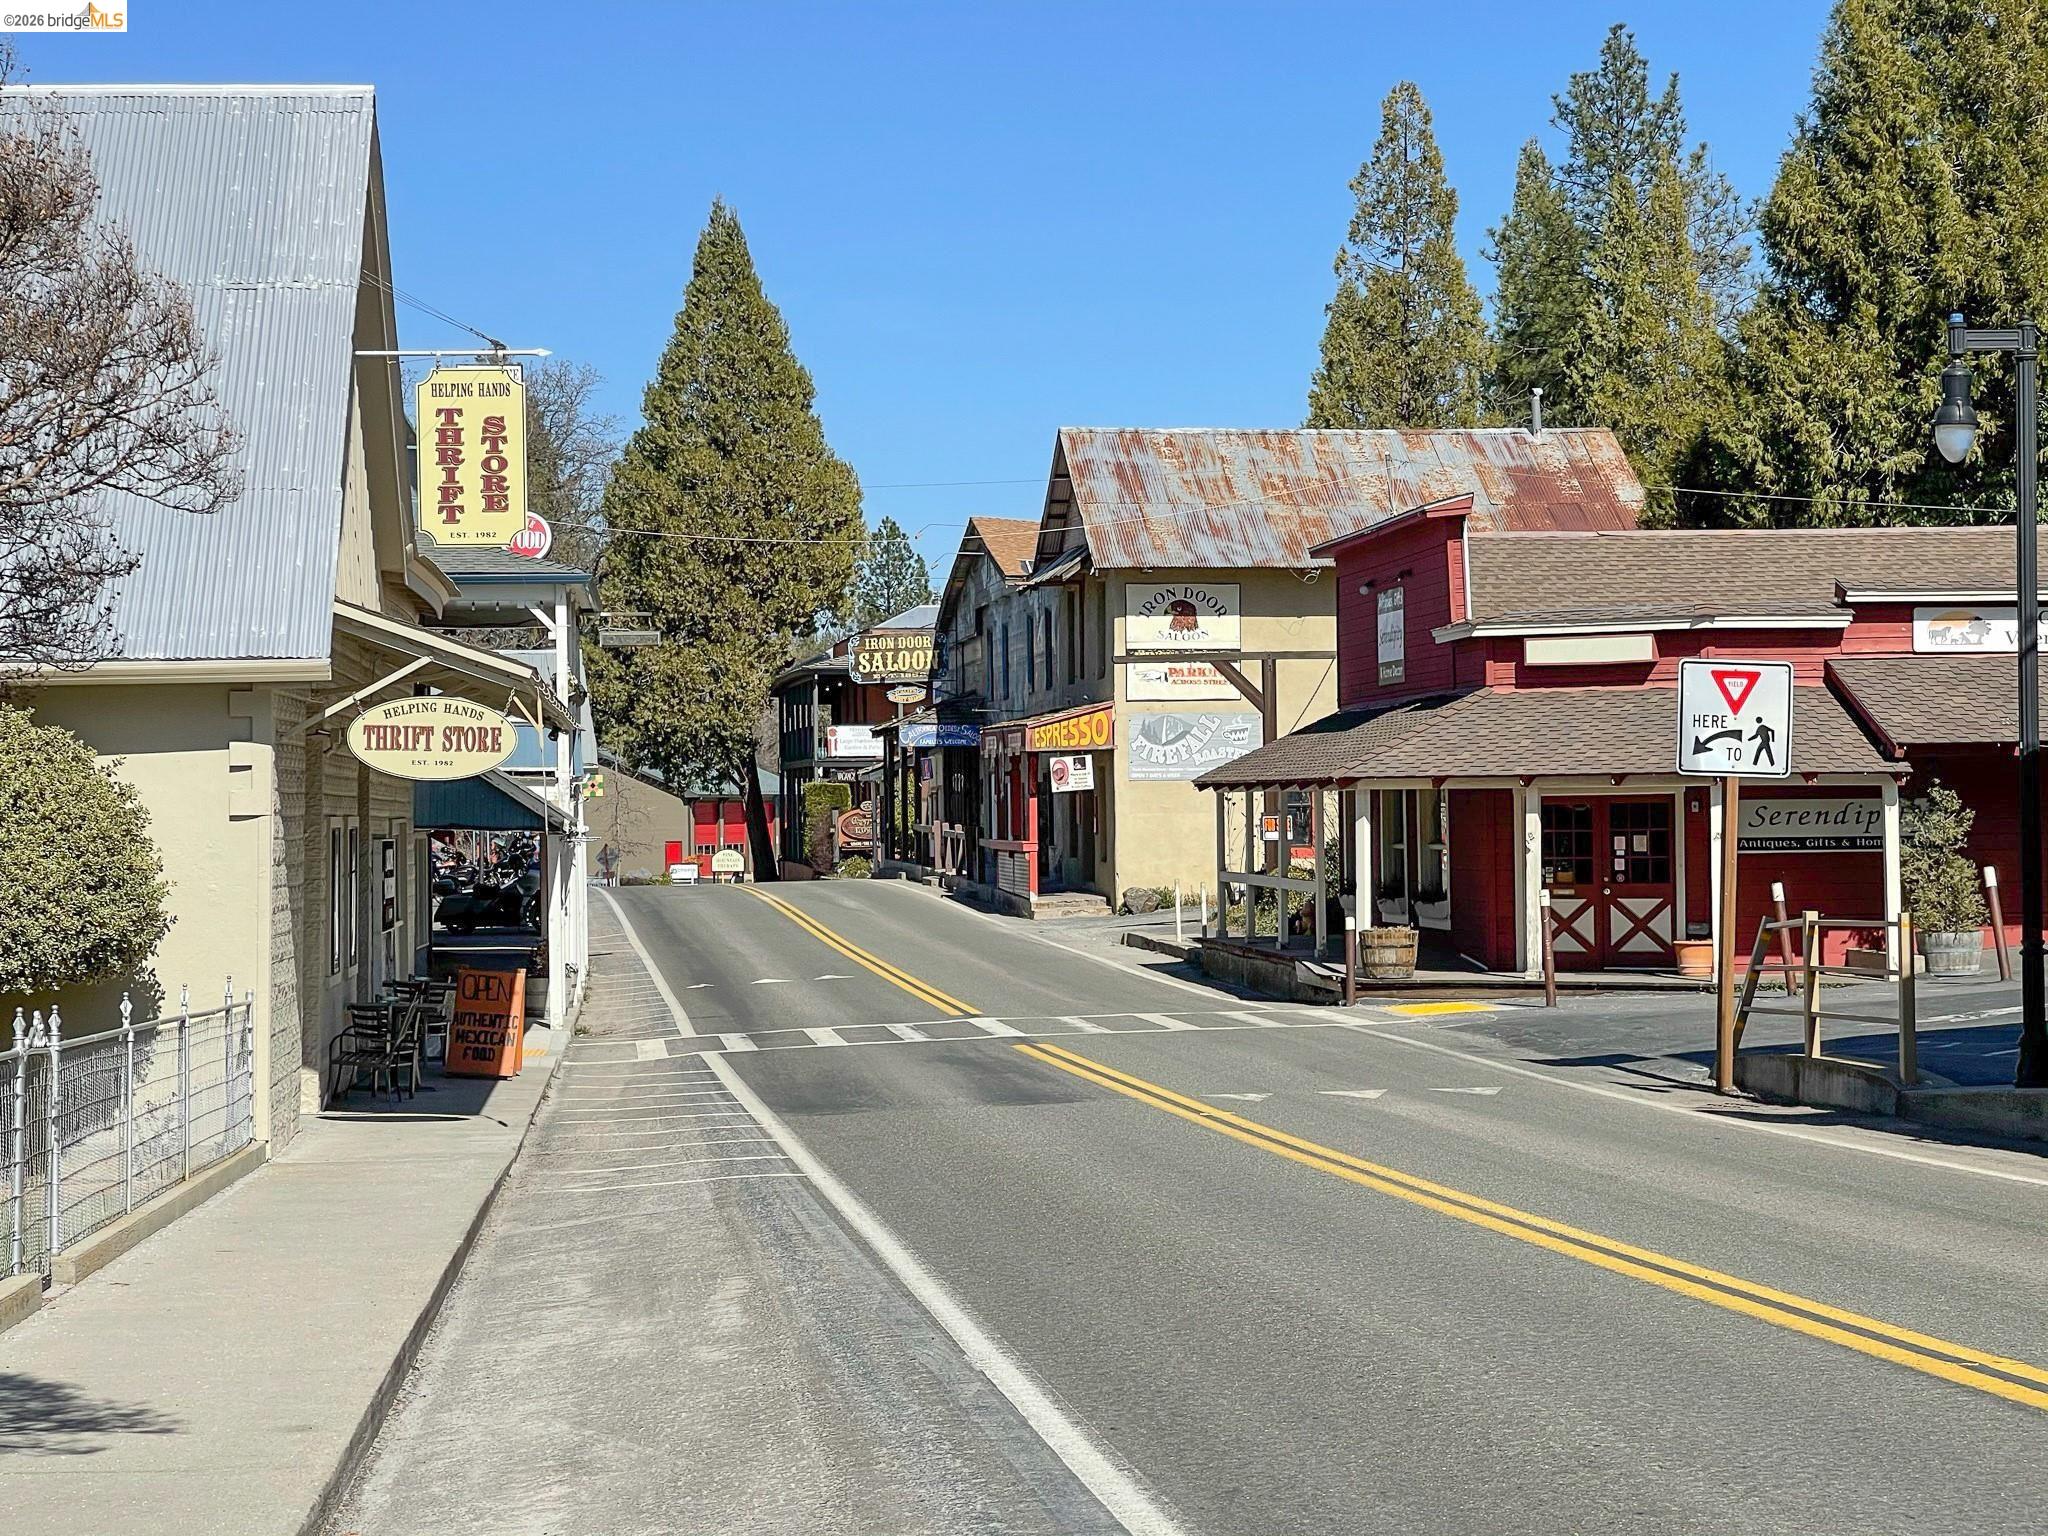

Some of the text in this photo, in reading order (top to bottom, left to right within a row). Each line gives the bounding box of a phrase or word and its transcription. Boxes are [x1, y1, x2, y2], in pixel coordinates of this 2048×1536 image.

[431, 383, 511, 397] HELPING HANDS
[435, 408, 465, 525] THRIFT
[480, 416, 510, 513] STORE
[1139, 587, 1228, 618] IRON DOOR
[865, 635, 932, 650] IRON DOOR
[1158, 630, 1209, 641] SALOON
[858, 650, 940, 673] SALOON
[383, 702, 485, 721] HELPING HANDS
[1693, 714, 1728, 728] HERE
[363, 724, 502, 753] THRIFT STORE
[1034, 712, 1109, 748] ESPRESSO
[1130, 714, 1222, 765] FIREFALL
[1726, 748, 1742, 761] TO
[1748, 802, 1905, 834] Serendip
[1739, 838, 1883, 849] Antiques, Gifts & Hom
[462, 974, 513, 1001] OPEN
[455, 1028, 516, 1046] MEXICAN
[463, 1046, 496, 1061] FOOD
